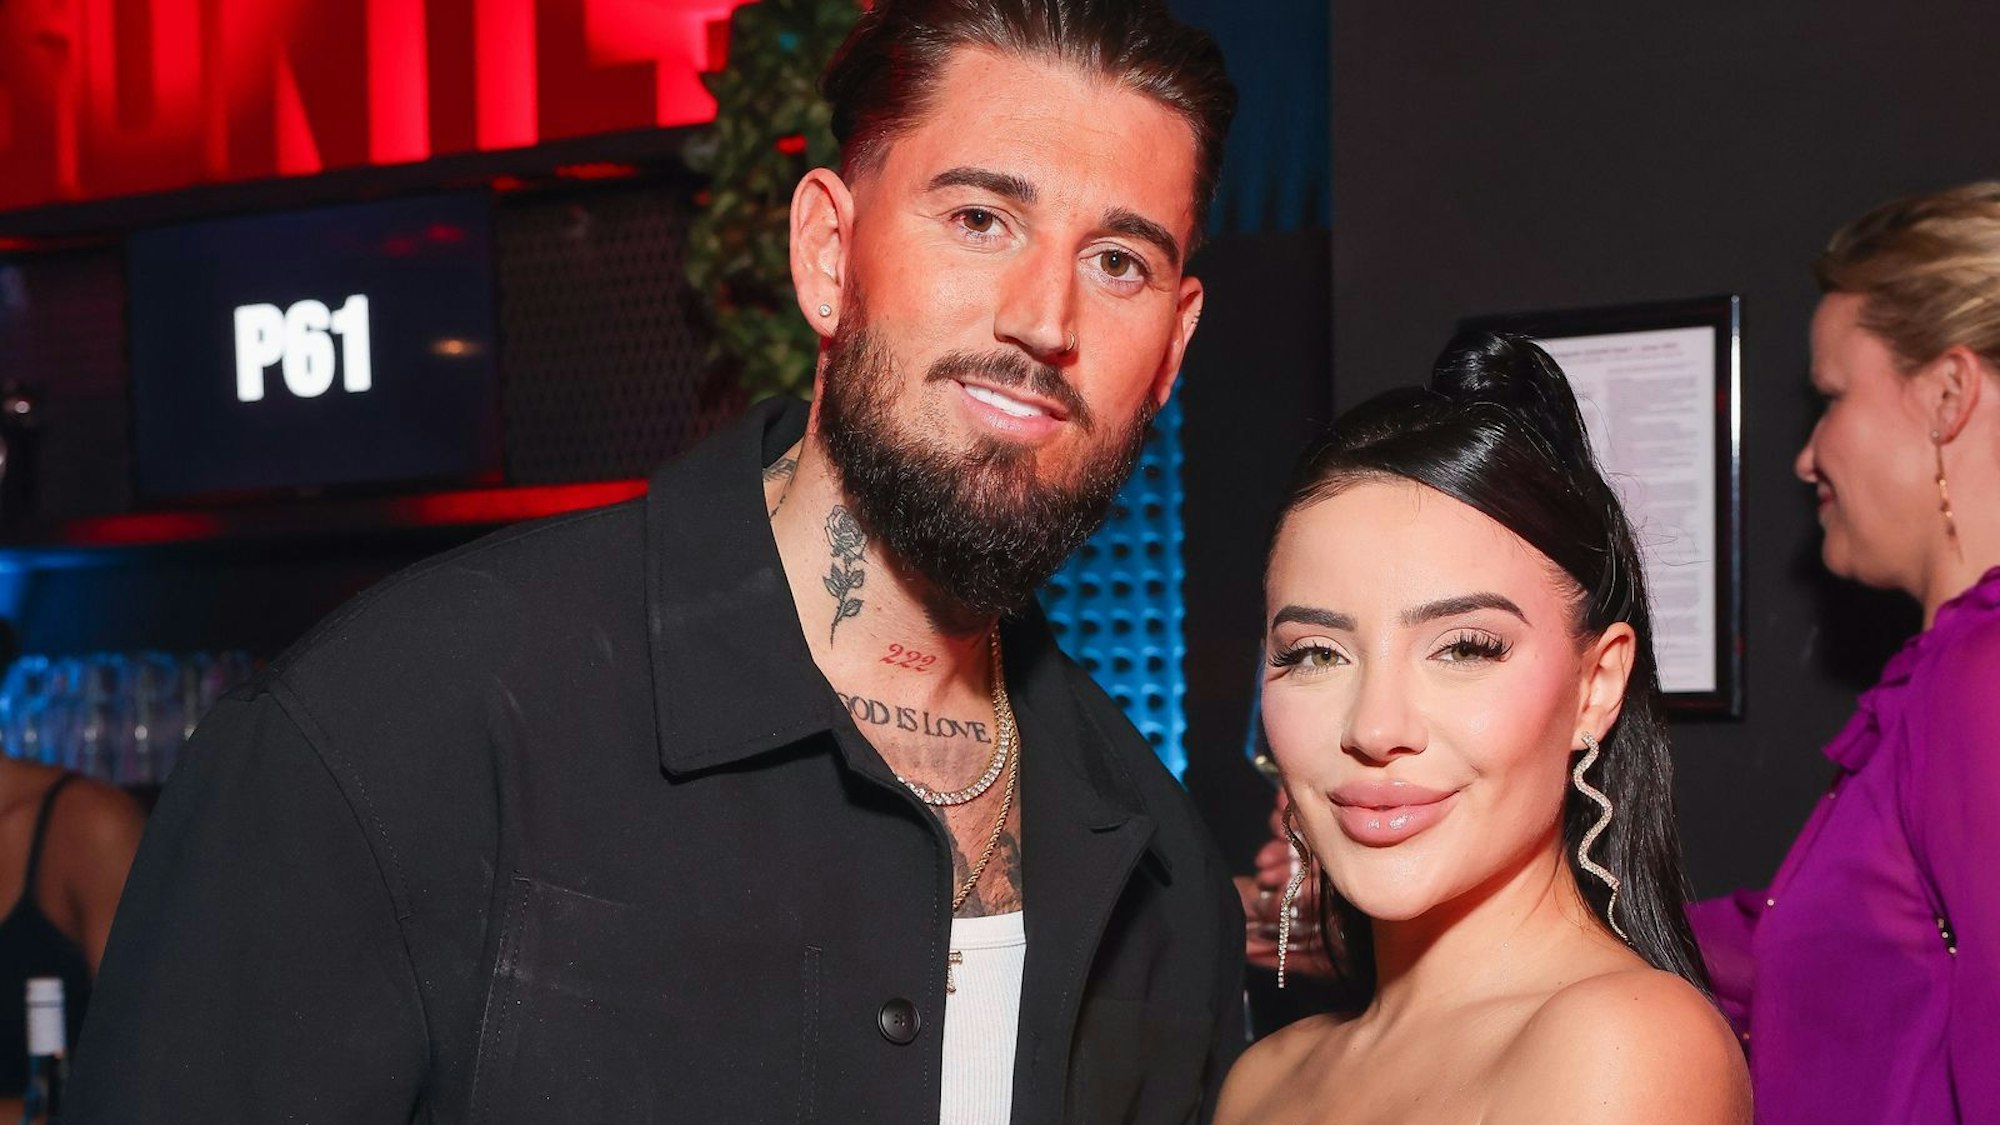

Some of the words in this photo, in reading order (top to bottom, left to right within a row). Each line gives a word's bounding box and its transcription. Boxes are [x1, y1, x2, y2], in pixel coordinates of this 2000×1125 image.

[233, 294, 372, 402] P61
[880, 643, 937, 672] 222
[895, 706, 919, 732] IS
[922, 712, 992, 744] LOVE
